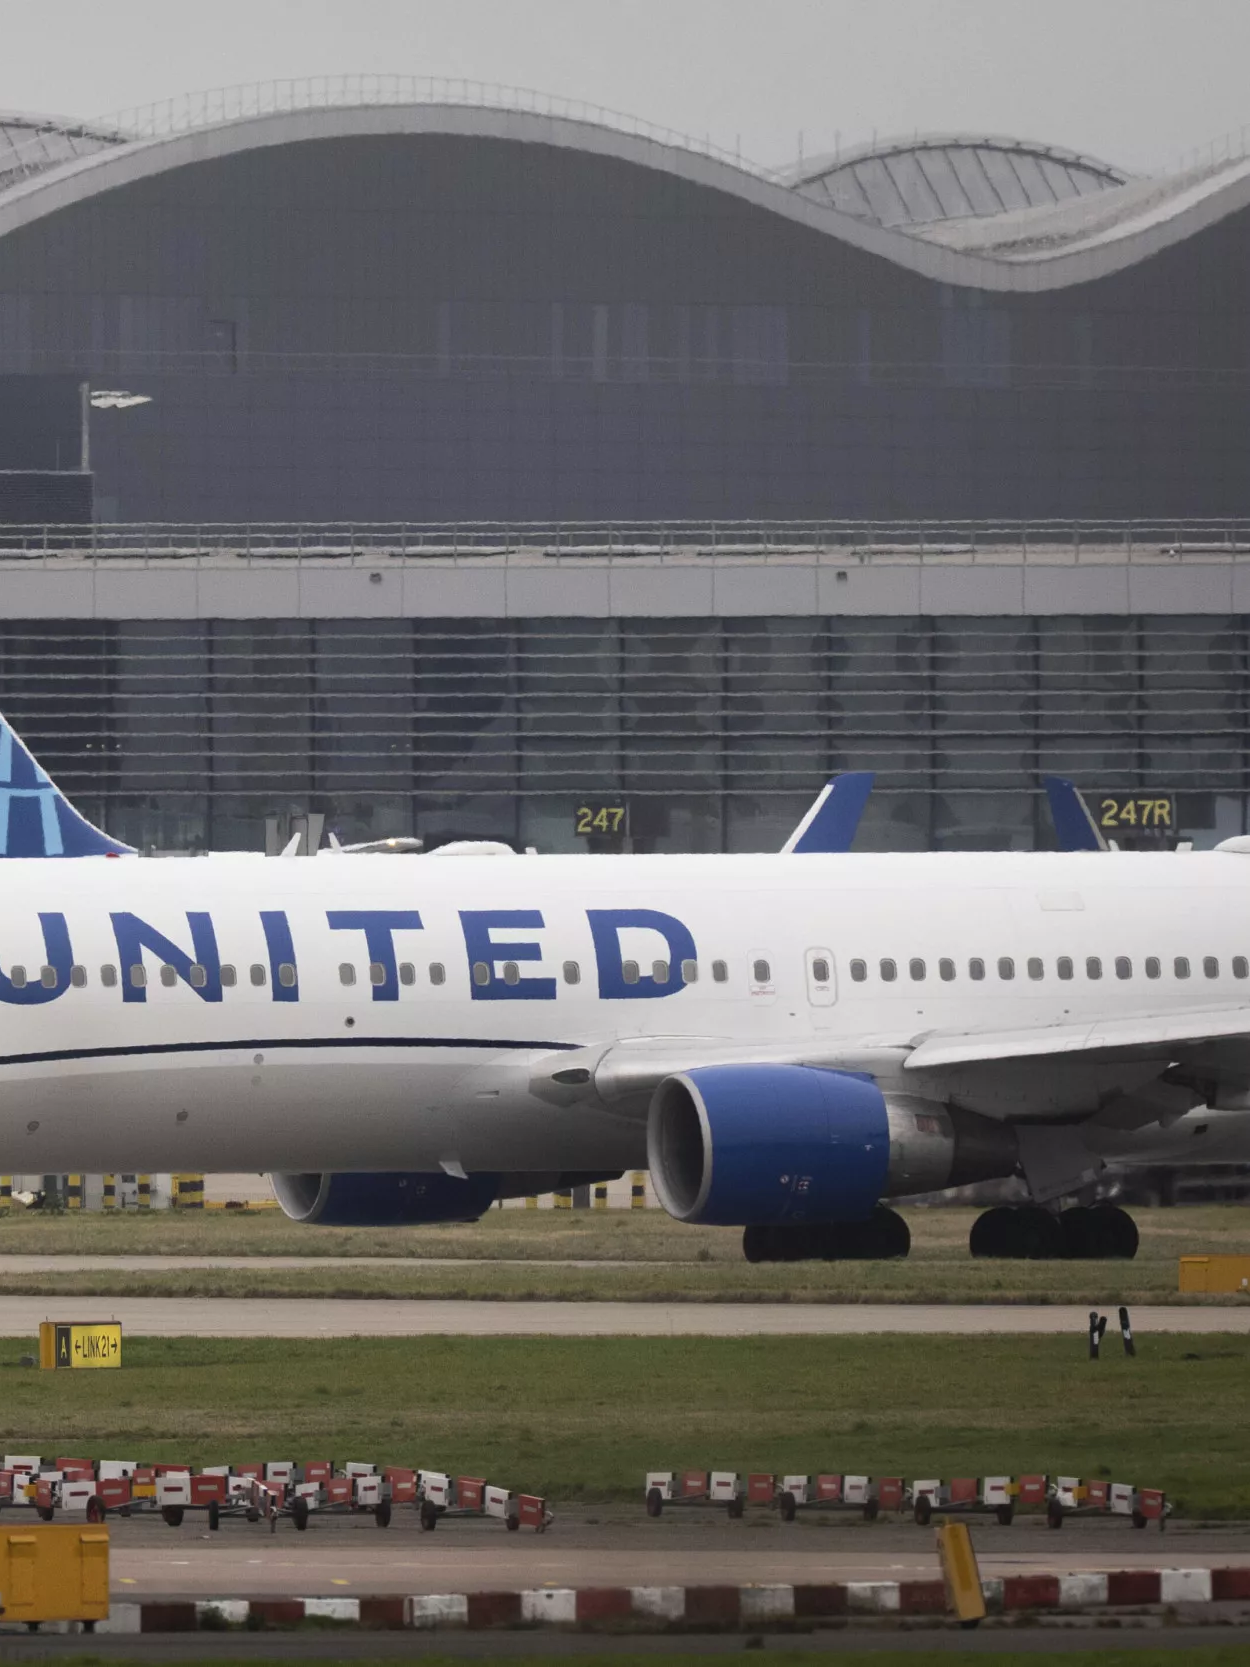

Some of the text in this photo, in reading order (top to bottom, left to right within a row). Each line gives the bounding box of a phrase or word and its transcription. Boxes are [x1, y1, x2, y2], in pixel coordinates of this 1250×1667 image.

[577, 807, 624, 832] 247
[1101, 799, 1170, 826] 247R
[61, 1336, 67, 1358] A
